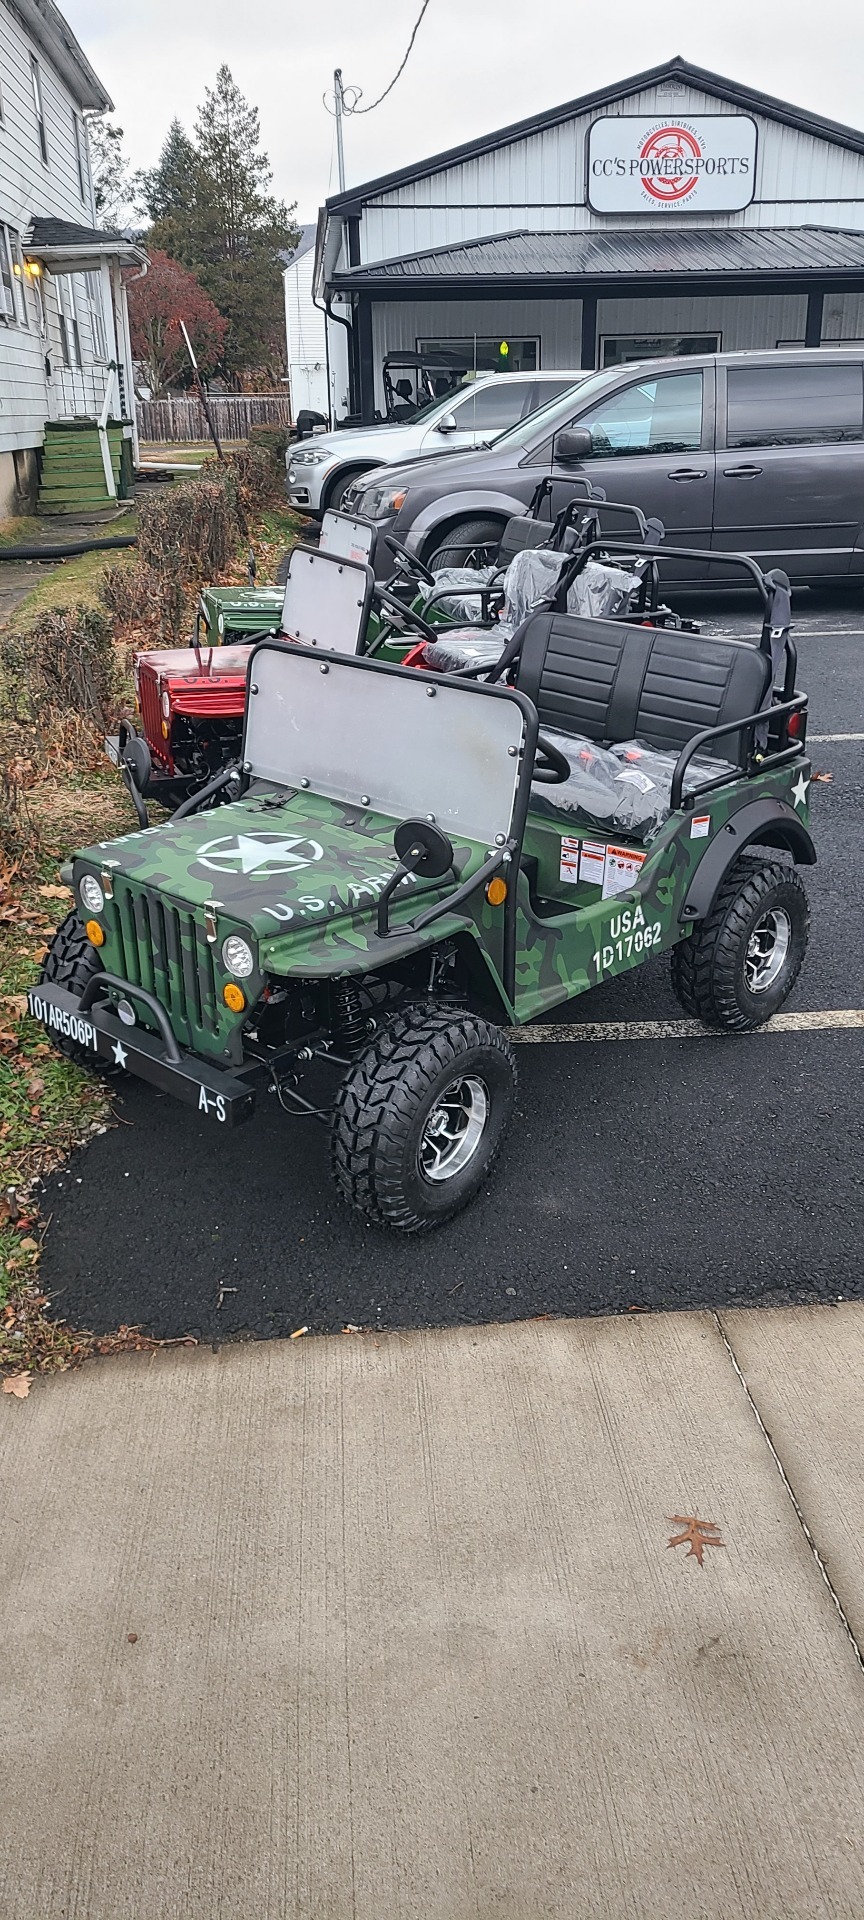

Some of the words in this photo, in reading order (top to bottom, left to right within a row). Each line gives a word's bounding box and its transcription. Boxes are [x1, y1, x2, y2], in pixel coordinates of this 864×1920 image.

[592, 157, 626, 177] CC'S
[629, 157, 750, 176] POWERSPORTS
[617, 850, 643, 861] WARNING
[261, 895, 335, 921] U.S.
[610, 905, 645, 939] USA
[593, 921, 662, 973] 1D17062
[198, 1085, 226, 1122] A-S
